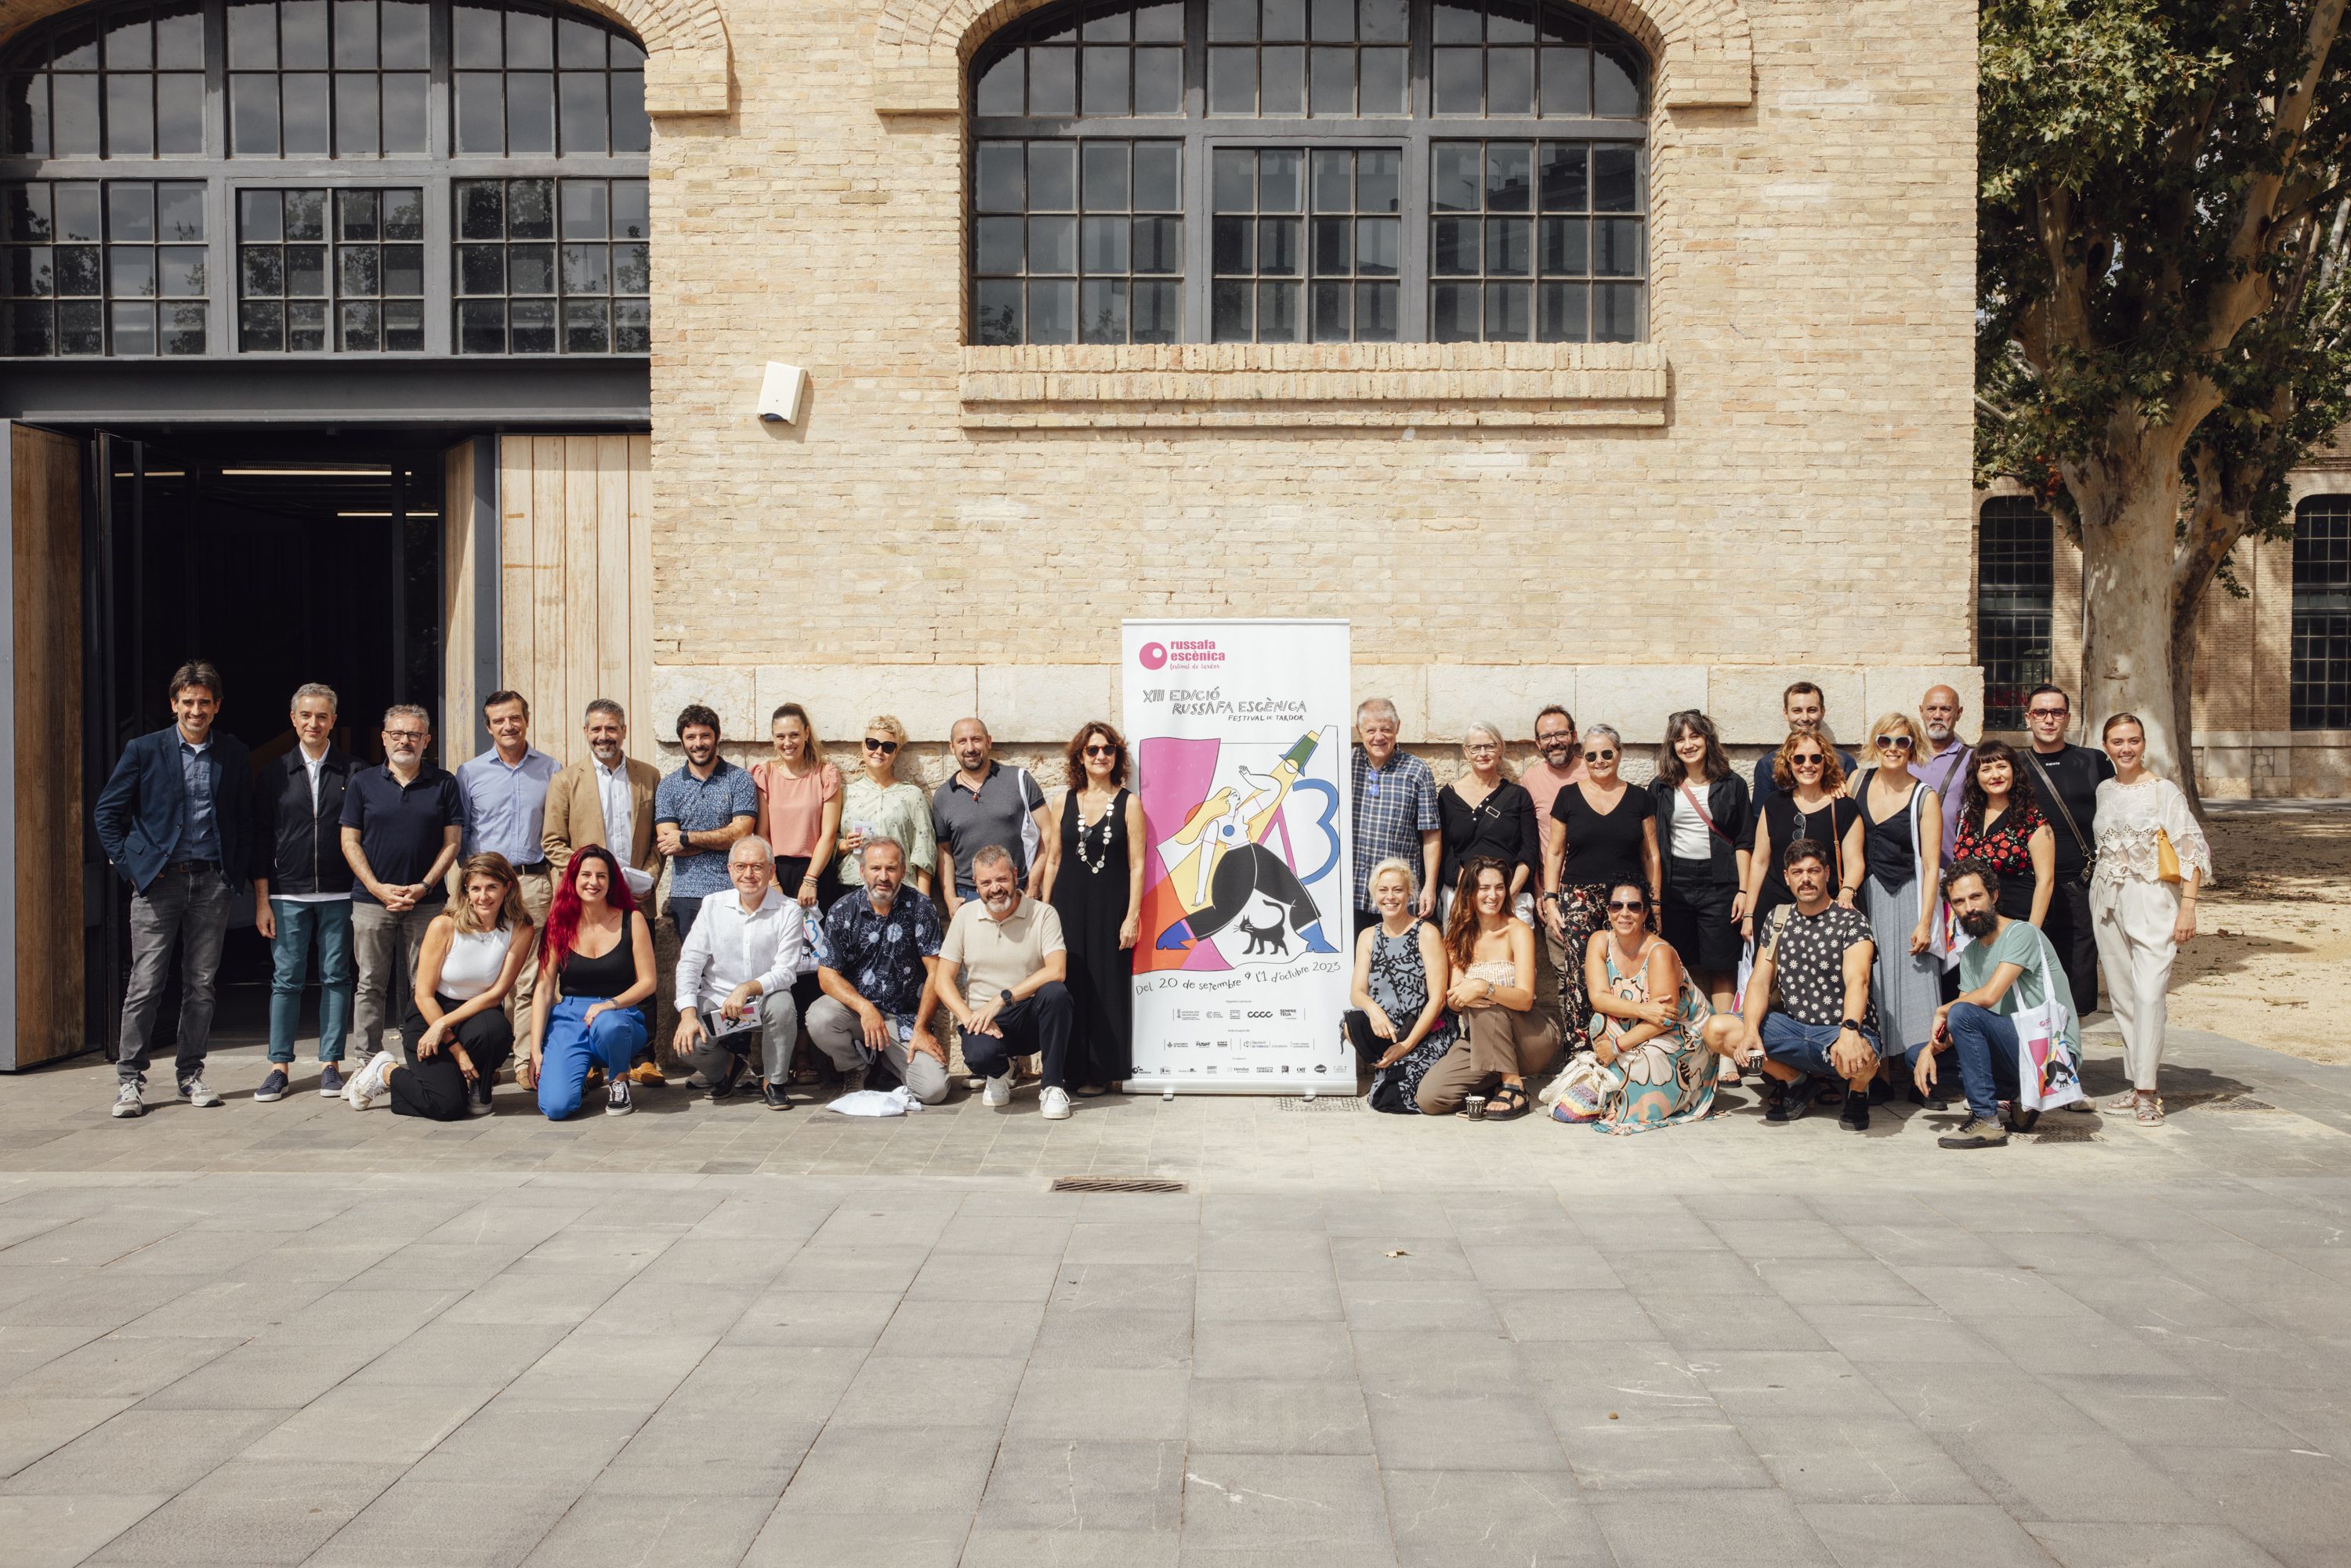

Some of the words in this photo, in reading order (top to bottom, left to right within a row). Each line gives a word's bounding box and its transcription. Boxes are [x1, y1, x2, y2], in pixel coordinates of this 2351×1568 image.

[1170, 639, 1216, 650] russafa
[1170, 650, 1226, 661] escènica
[1143, 690, 1165, 703] XIII
[1169, 686, 1220, 701] EDICIÓ
[1172, 701, 1234, 715] RUSSAFA
[1238, 697, 1307, 713] ESCÈNICA
[1136, 982, 1154, 996] Del
[1159, 978, 1178, 989] 20
[1183, 980, 1195, 990] de
[1198, 979, 1241, 993] setembre
[1271, 966, 1310, 983] d'octubre
[1312, 961, 1341, 972] 2023
